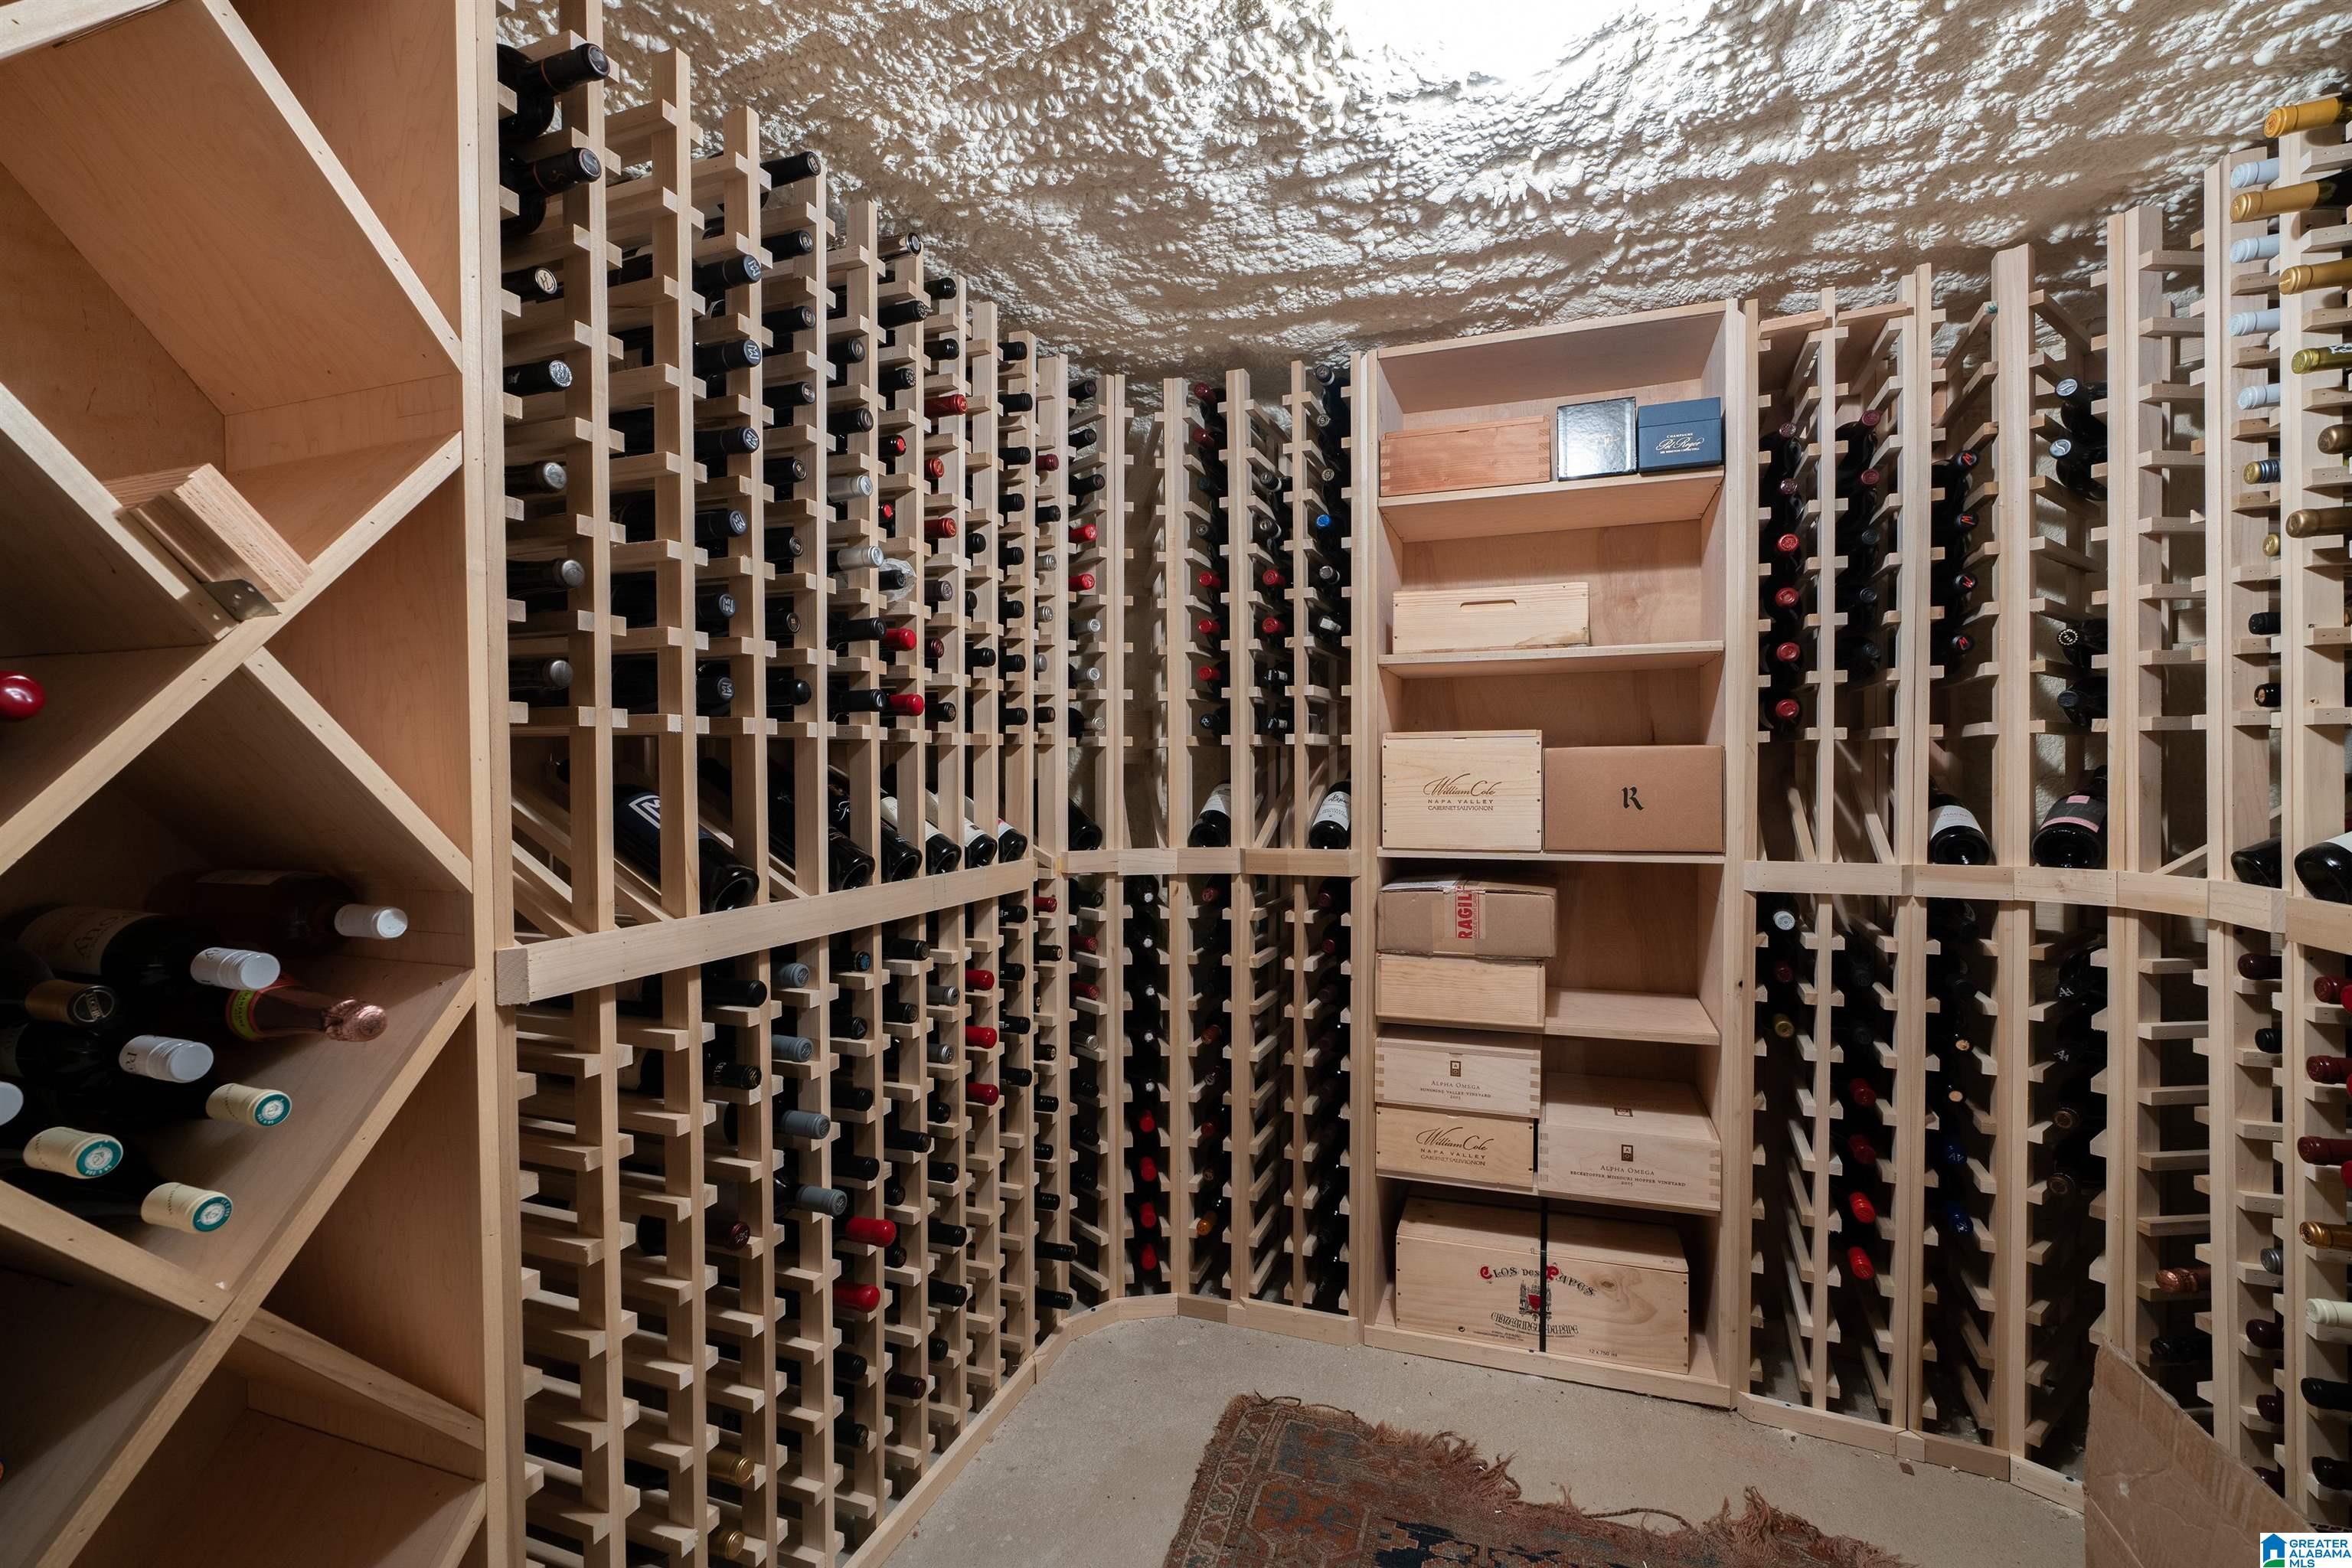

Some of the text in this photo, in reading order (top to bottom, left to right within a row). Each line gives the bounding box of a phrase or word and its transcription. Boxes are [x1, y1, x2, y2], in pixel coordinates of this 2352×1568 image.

[1673, 436, 1704, 451] Roger
[1423, 773, 1502, 796] William Cole
[1622, 786, 1645, 810] R
[1457, 887, 1473, 939] RAGIL
[1416, 1126, 1494, 1151] William Cole
[1449, 1158, 1486, 1166] SAUVIGNON
[1600, 1165, 1655, 1176] ALPHA OMEGA
